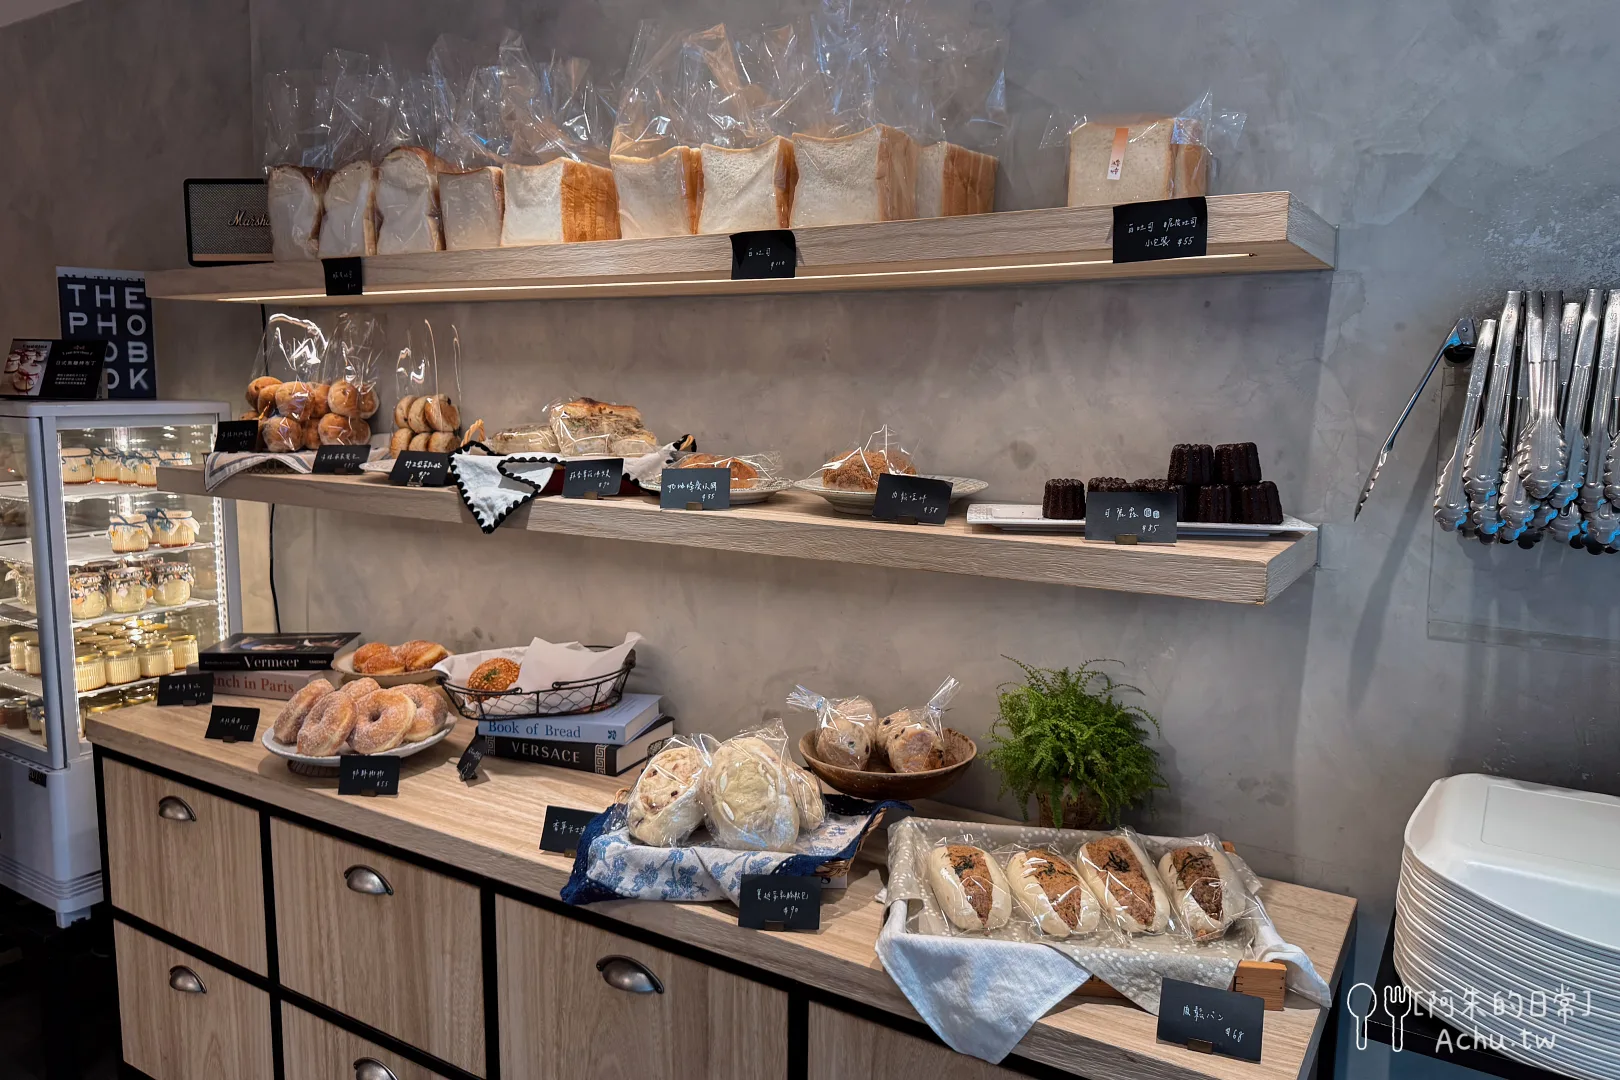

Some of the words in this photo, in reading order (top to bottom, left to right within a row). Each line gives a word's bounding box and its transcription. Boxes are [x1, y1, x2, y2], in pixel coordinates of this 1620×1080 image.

[1177, 236, 1194, 247] $55
[66, 283, 146, 310] THE
[68, 311, 147, 336] PHO
[104, 341, 148, 363] OB
[243, 655, 300, 669] Vermeer
[244, 676, 257, 690] in
[260, 677, 295, 693] Paris
[488, 721, 520, 734] Book
[525, 723, 539, 735] of
[545, 725, 581, 739] Bread
[511, 741, 580, 763] VERSACE
[1225, 1027, 1245, 1043] $68
